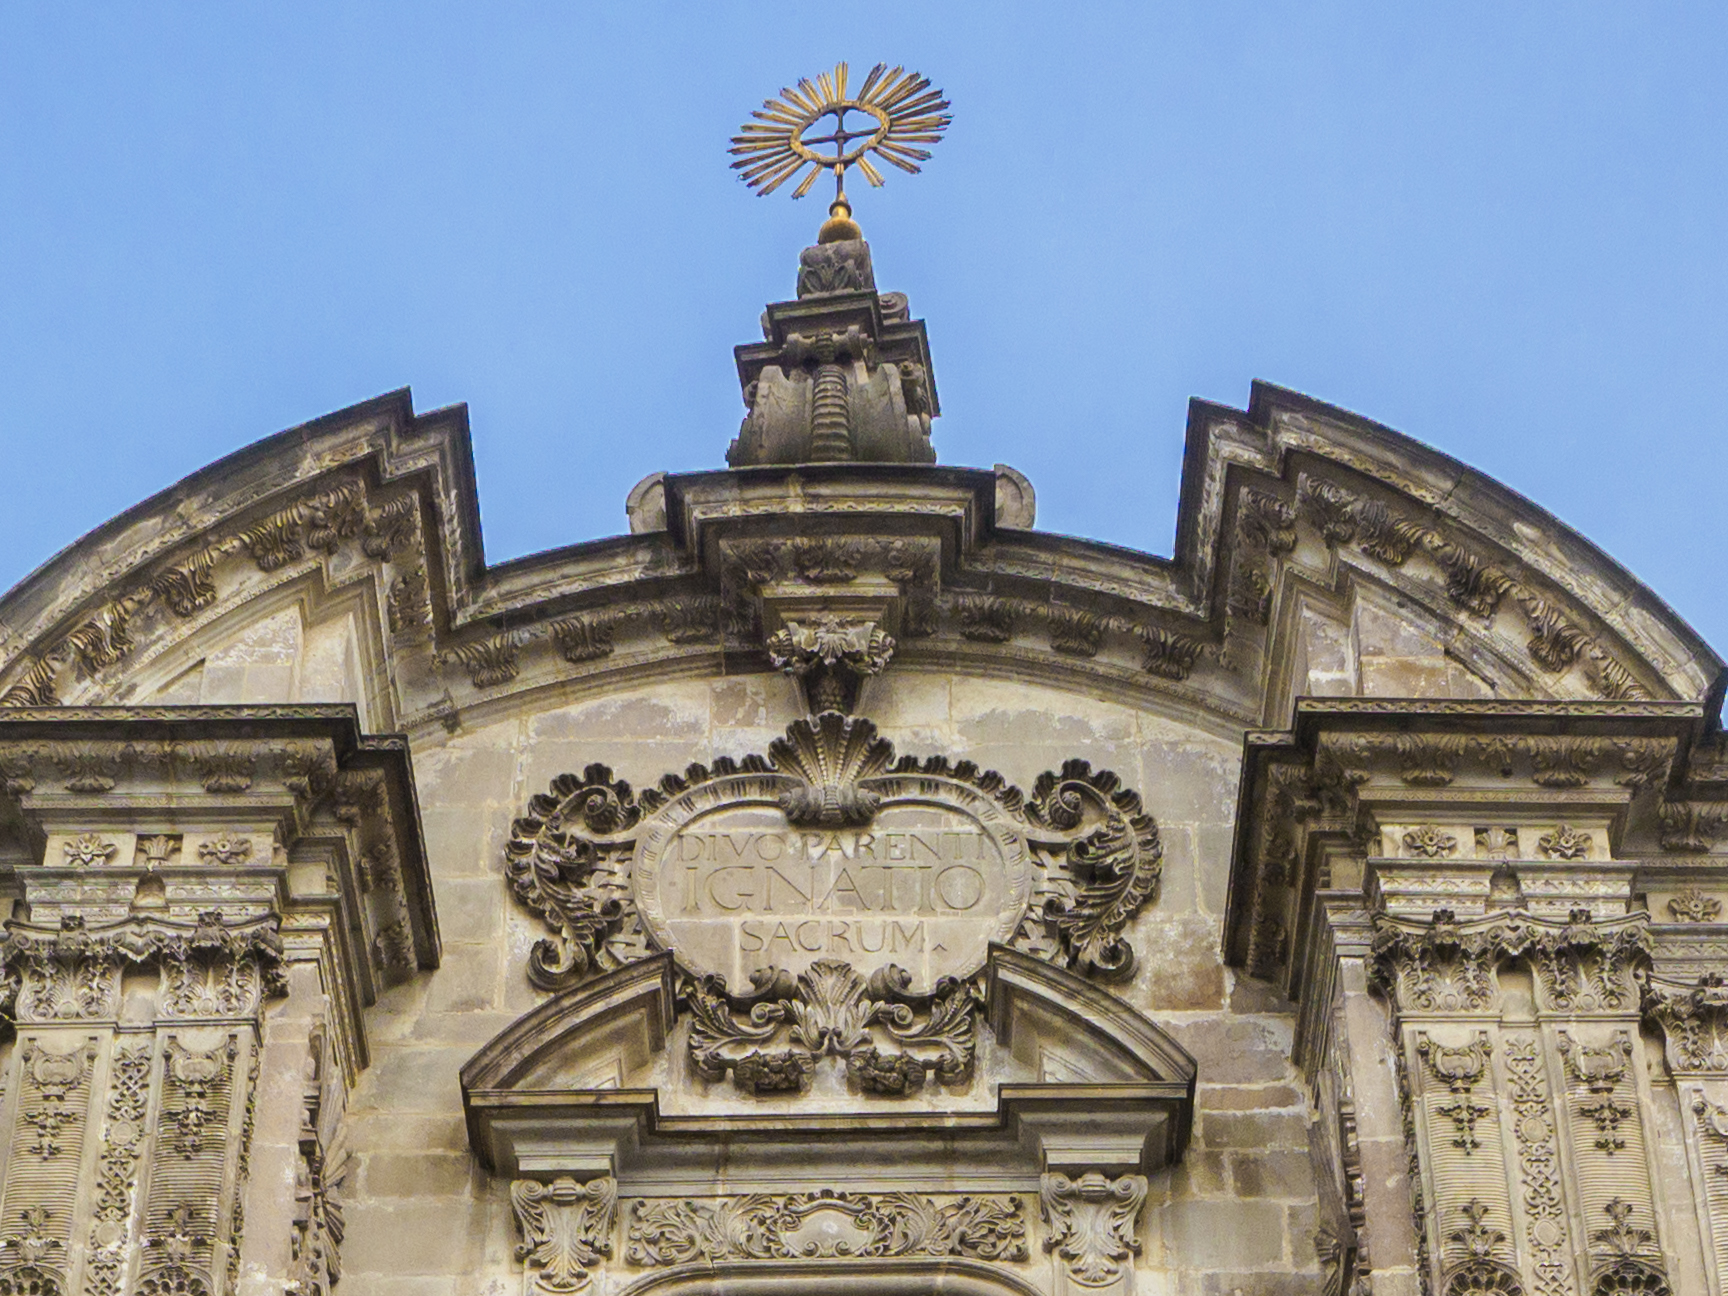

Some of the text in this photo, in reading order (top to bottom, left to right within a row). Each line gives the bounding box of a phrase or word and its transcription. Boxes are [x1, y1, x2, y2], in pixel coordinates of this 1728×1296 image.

[676, 832, 988, 861] DIVO PARENTI
[680, 863, 988, 912] IGNATIO
